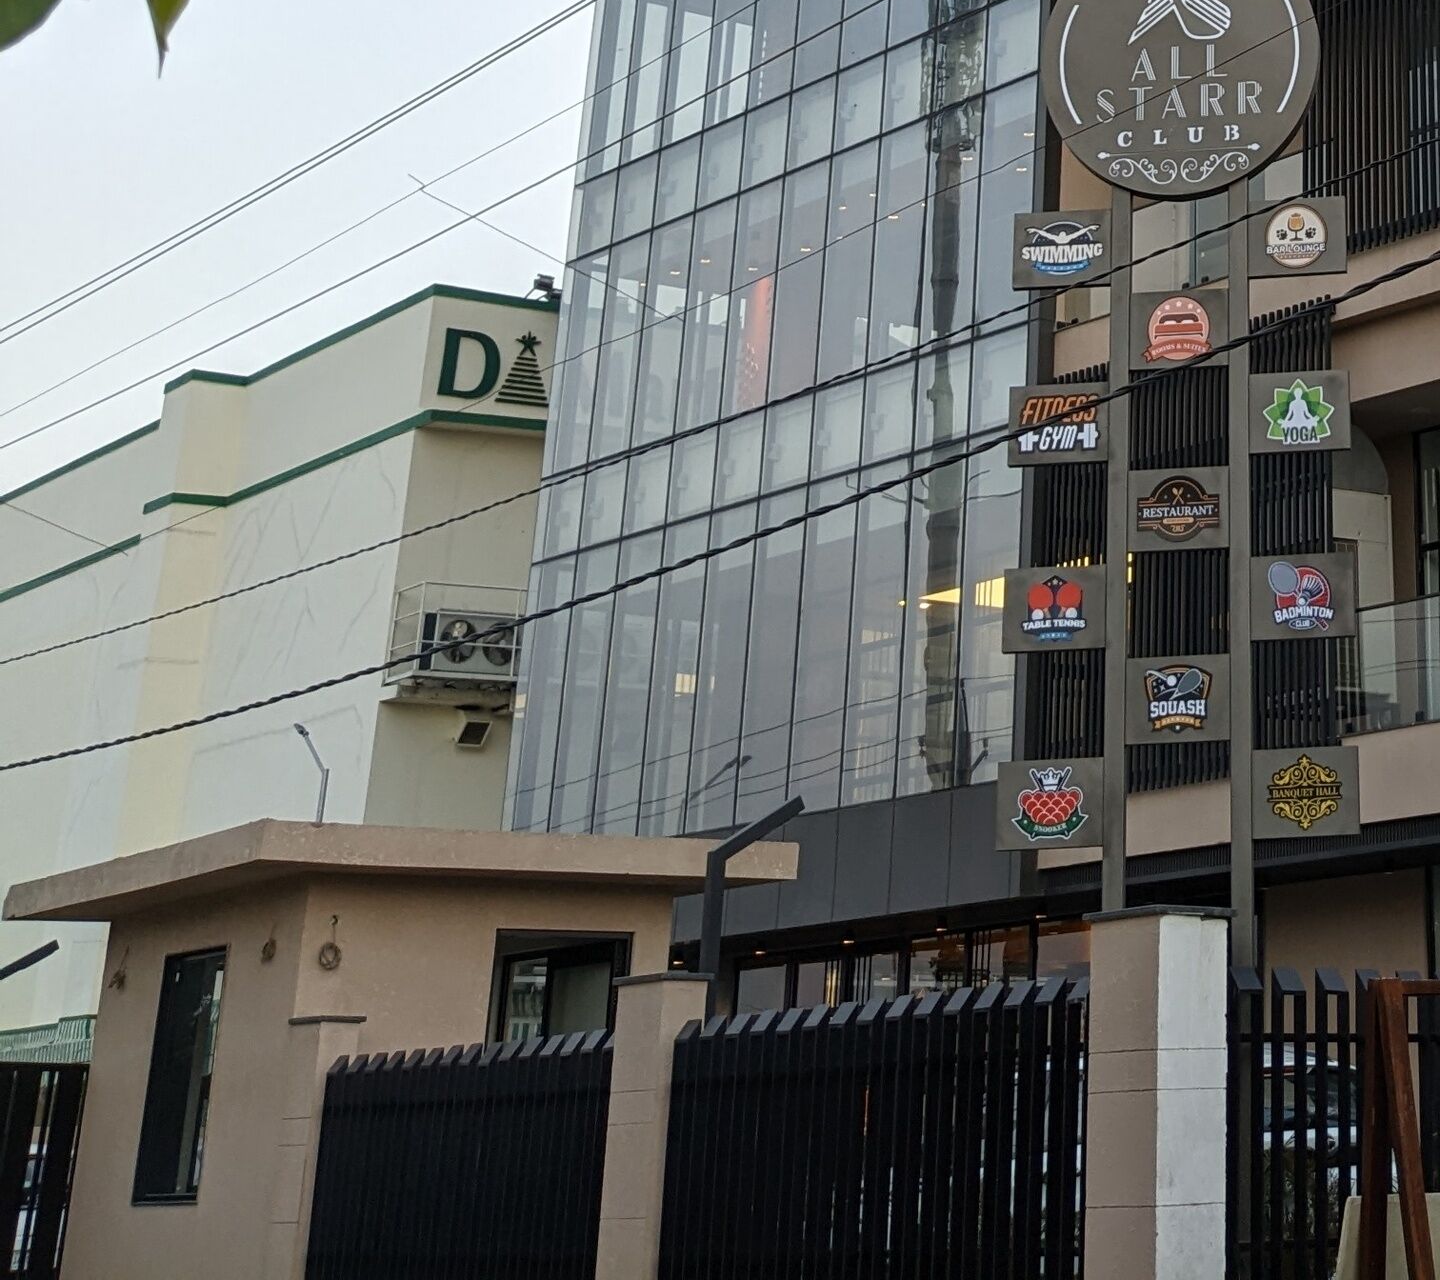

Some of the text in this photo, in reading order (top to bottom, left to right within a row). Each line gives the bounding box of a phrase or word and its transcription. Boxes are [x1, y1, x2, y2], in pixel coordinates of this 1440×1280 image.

[1132, 44, 1228, 82] ALL
[1096, 81, 1262, 124] STARR
[1117, 125, 1240, 148] CLUB
[1021, 243, 1103, 264] SWIMMING
[1266, 243, 1326, 254] BAR LOUNGE
[1021, 395, 1099, 425] FITNESS
[1039, 425, 1078, 451] GYM
[1282, 426, 1318, 443] YOGA
[1142, 505, 1214, 518] RESTAURANT
[1274, 606, 1334, 623] BADMINTON
[1022, 619, 1086, 631] TABLE TENNIS
[1273, 786, 1338, 799] BANQUET HALL
